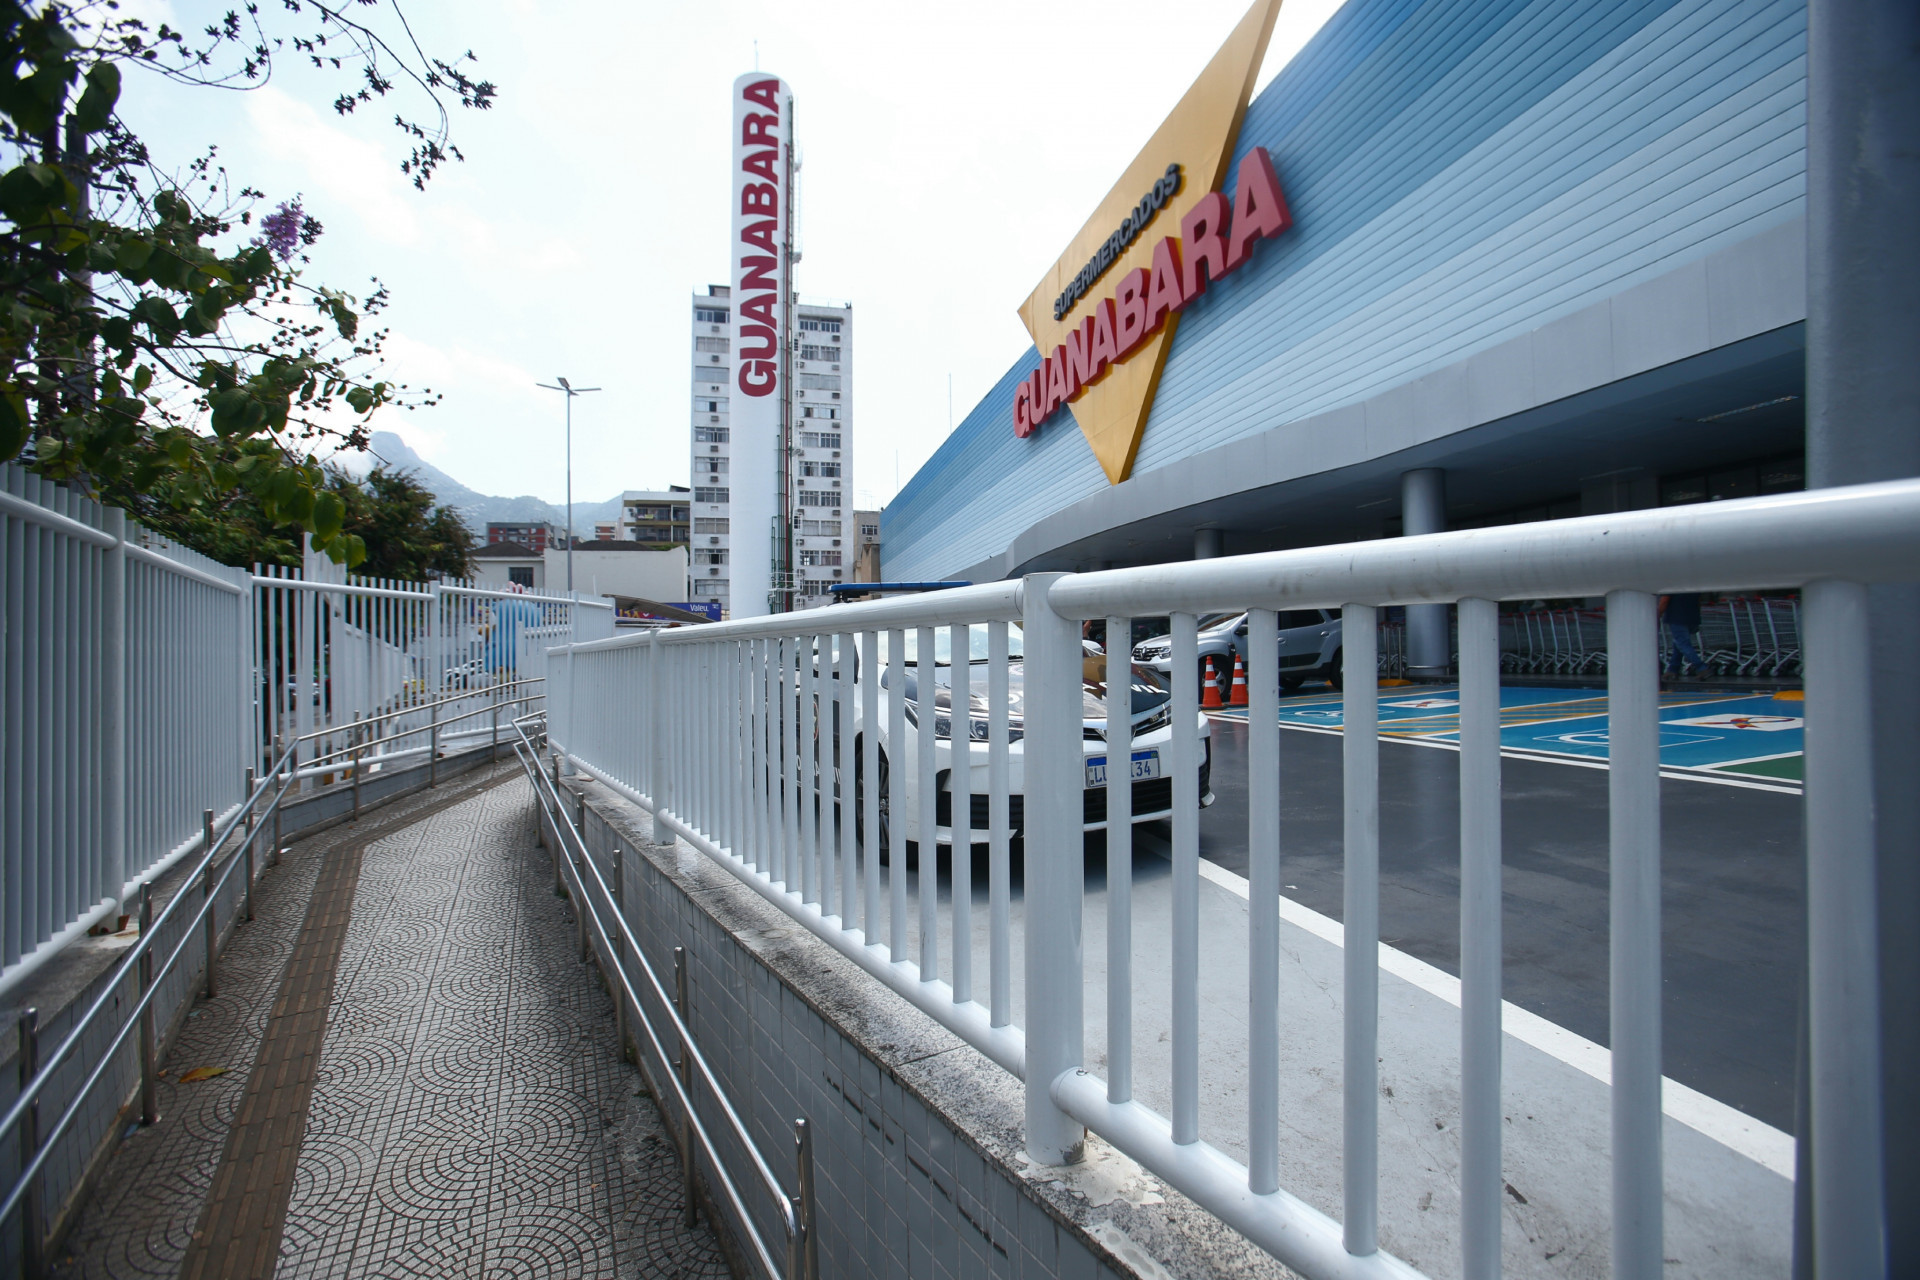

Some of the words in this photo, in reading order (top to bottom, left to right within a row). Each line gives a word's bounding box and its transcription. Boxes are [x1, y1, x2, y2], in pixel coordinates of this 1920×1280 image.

[738, 79, 780, 397] GUANABARA
[1012, 146, 1292, 439] GUANABARA
[1053, 162, 1181, 321] SUPERMERCADOS
